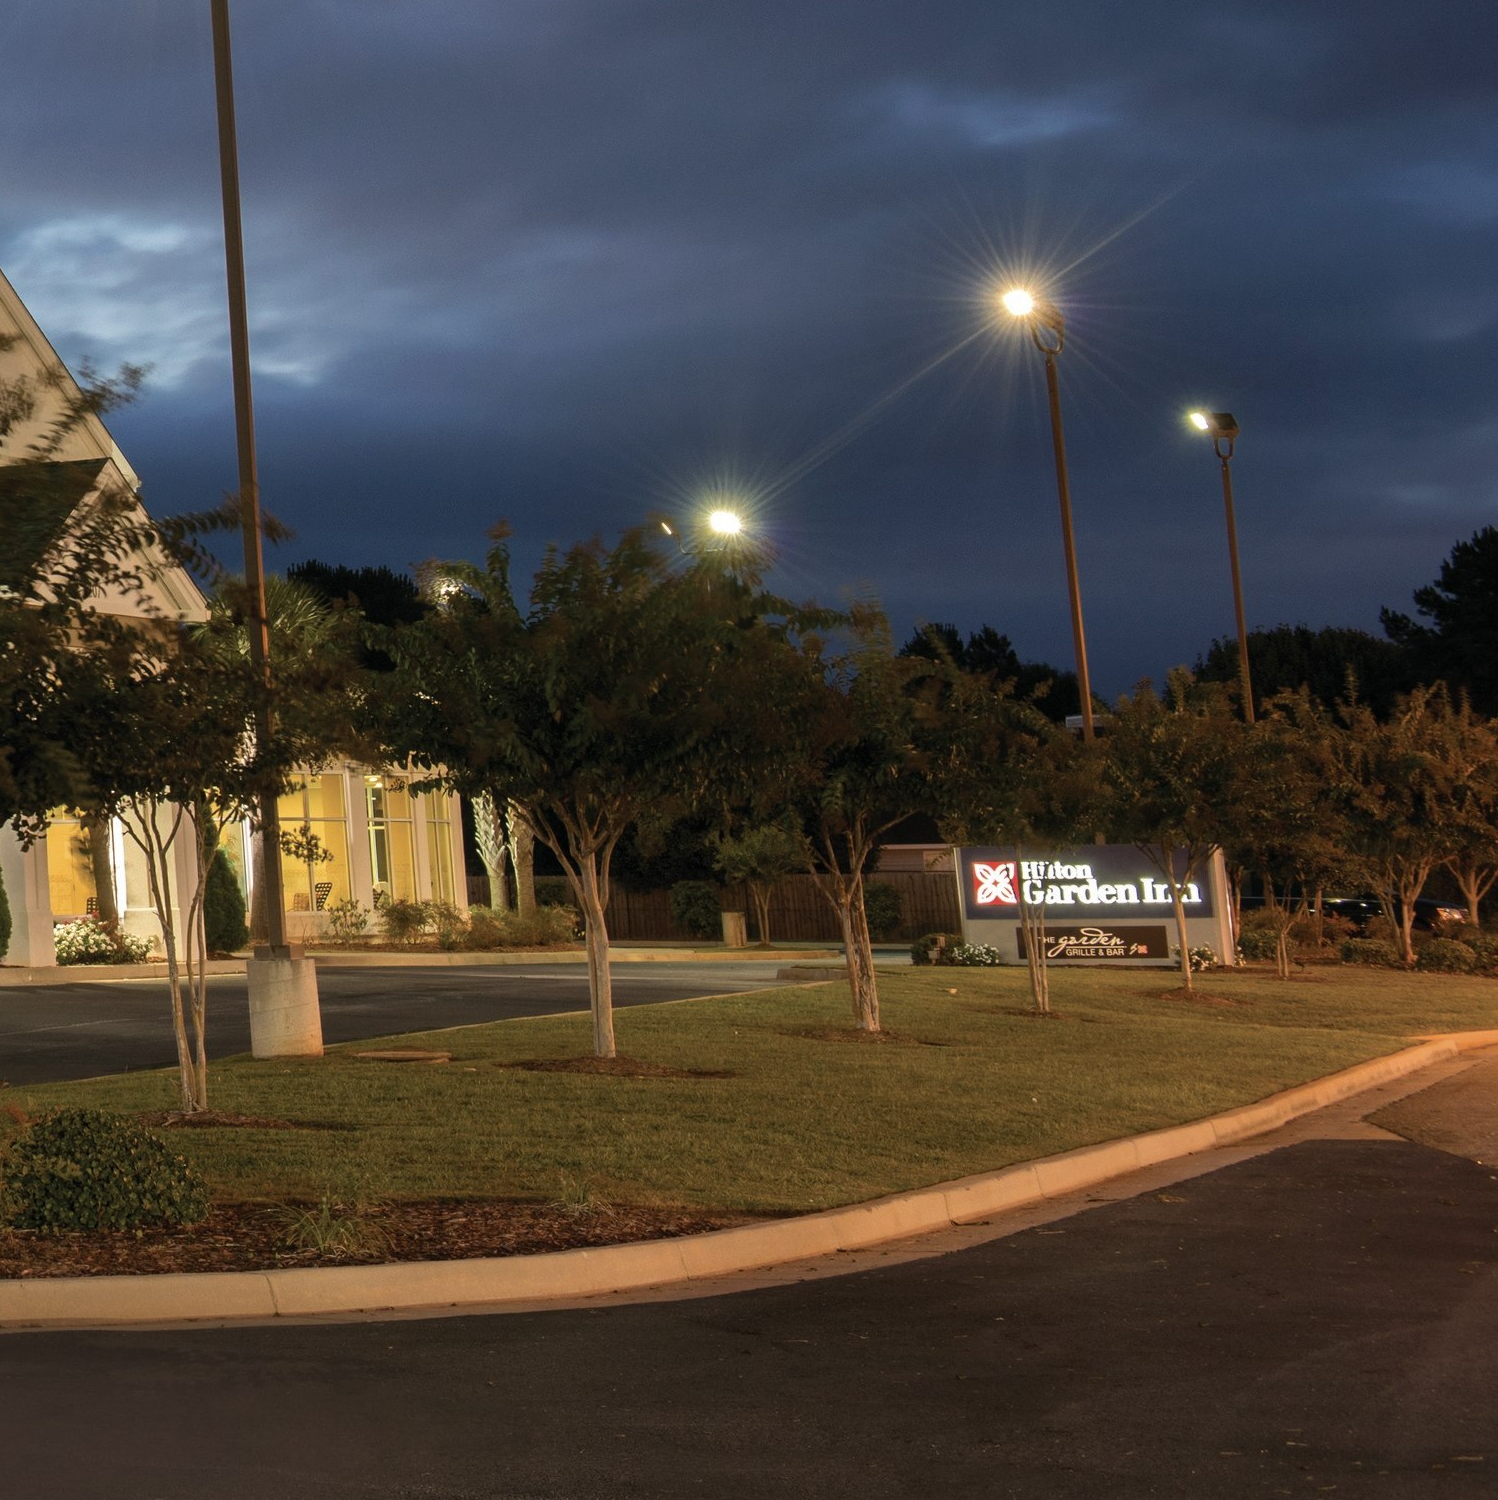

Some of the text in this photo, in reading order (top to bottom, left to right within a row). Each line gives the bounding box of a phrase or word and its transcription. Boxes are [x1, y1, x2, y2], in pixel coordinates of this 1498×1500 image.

[1022, 879, 1140, 904] Garden
[1038, 927, 1124, 958] HE garden
[1065, 948, 1125, 957] GRILLE & BAR
